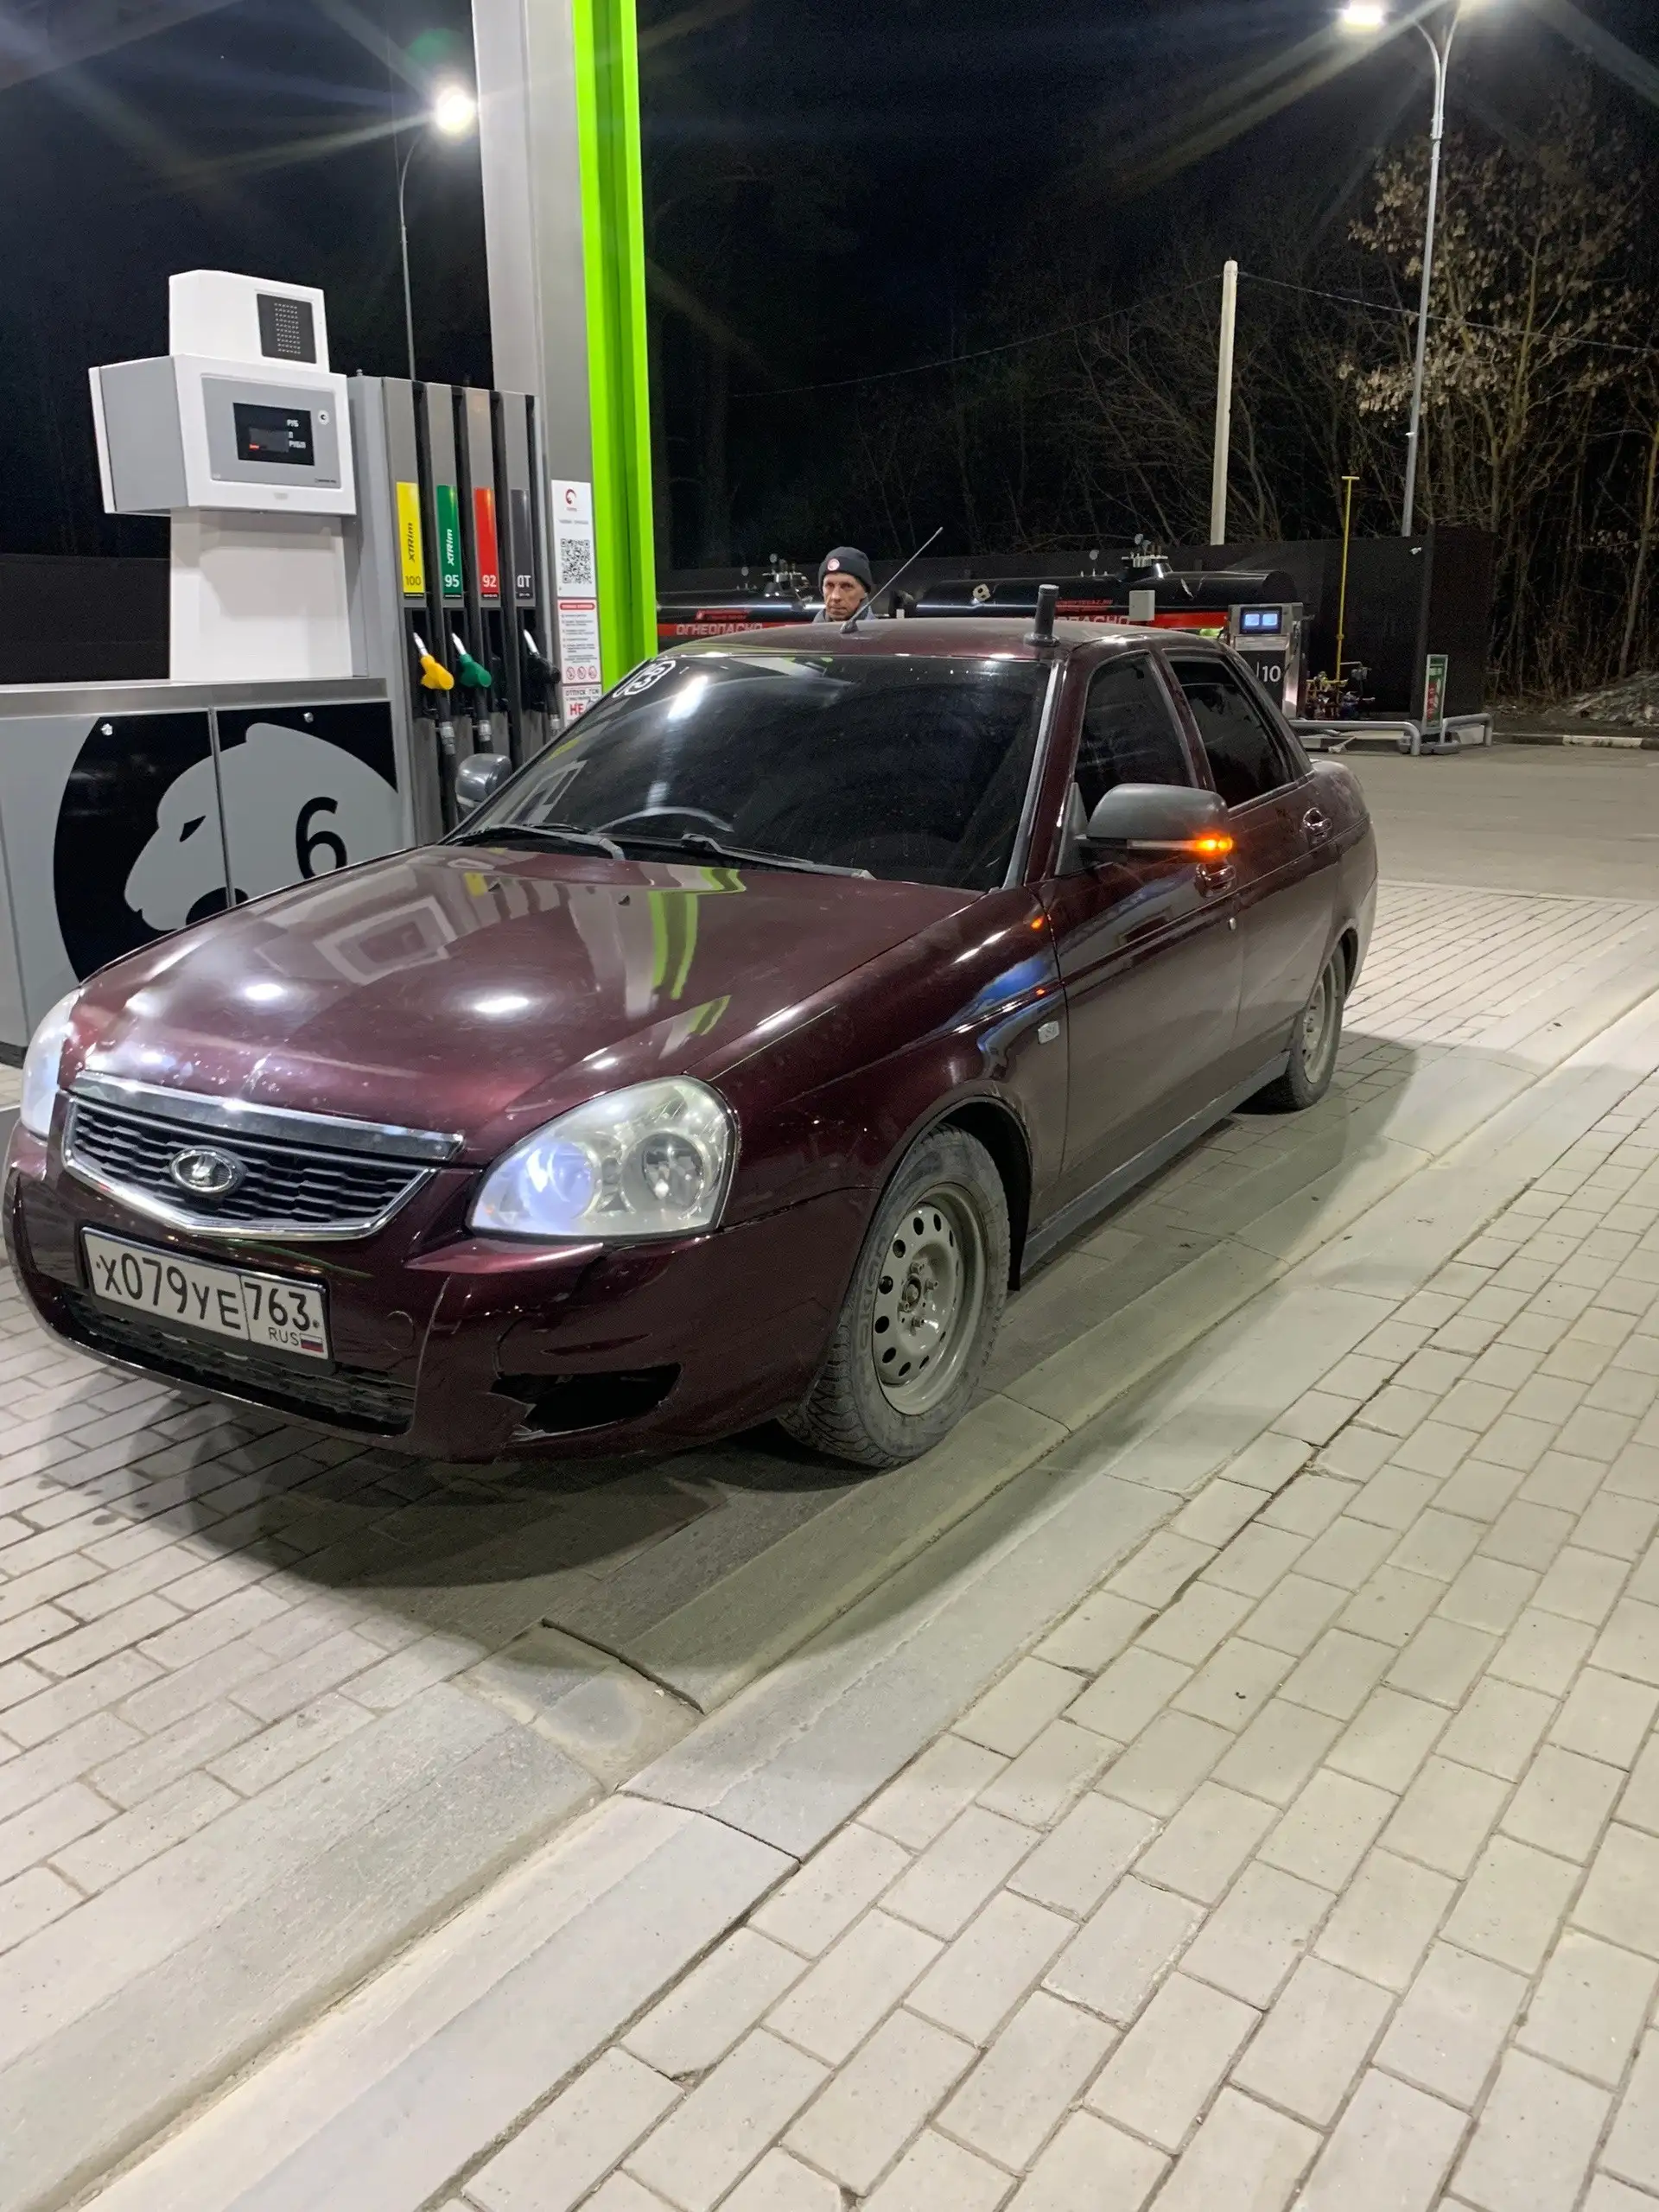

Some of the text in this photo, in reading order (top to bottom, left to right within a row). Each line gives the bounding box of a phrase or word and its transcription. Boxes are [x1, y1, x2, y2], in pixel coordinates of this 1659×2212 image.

[405, 575, 422, 586] 100
[444, 574, 460, 588] 95
[482, 574, 497, 588] 92
[1262, 665, 1281, 683] 10
[296, 797, 347, 880] 6
[245, 1282, 311, 1332] 763
[269, 1326, 299, 1346] RUS
